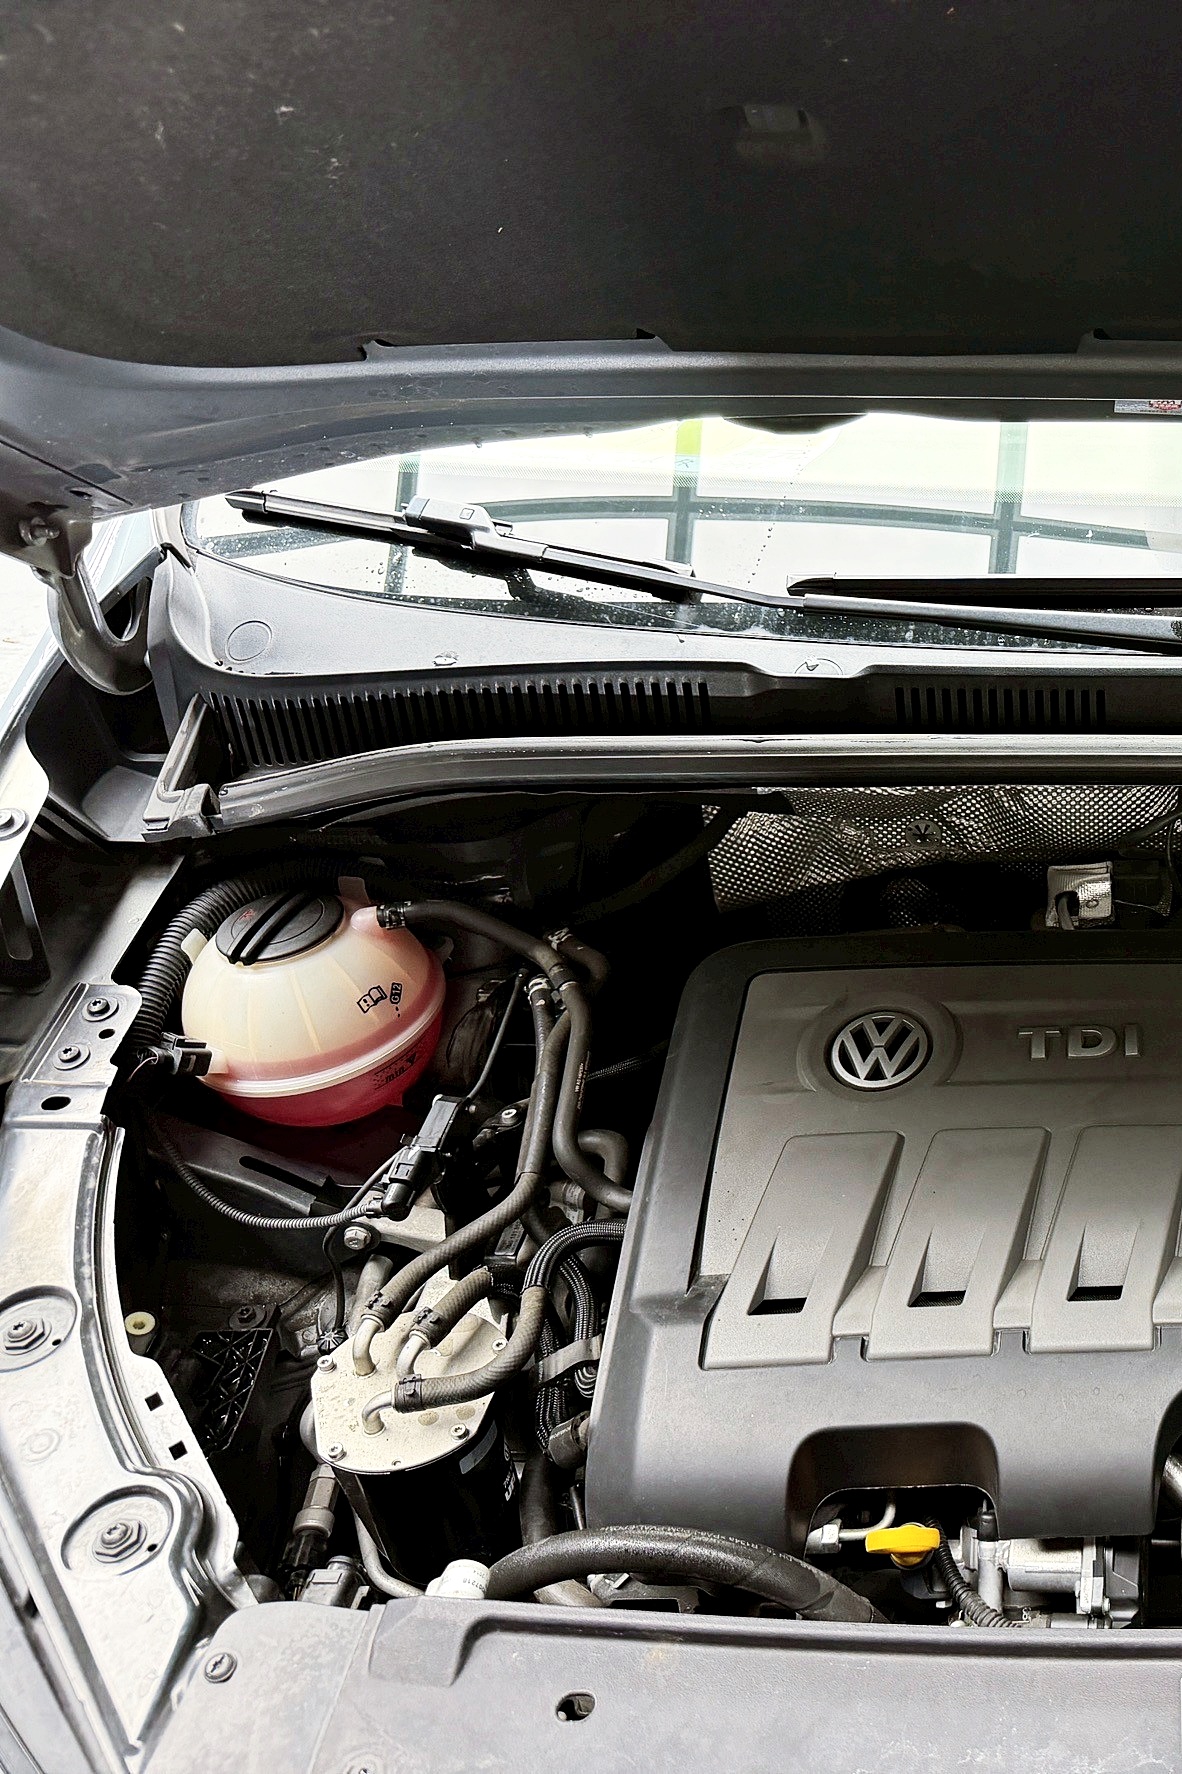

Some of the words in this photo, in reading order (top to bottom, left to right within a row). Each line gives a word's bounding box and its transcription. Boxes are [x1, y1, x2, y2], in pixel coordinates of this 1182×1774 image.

[391, 983, 402, 1004] G12
[832, 1014, 928, 1088] VW
[1018, 1025, 1142, 1060] TDI
